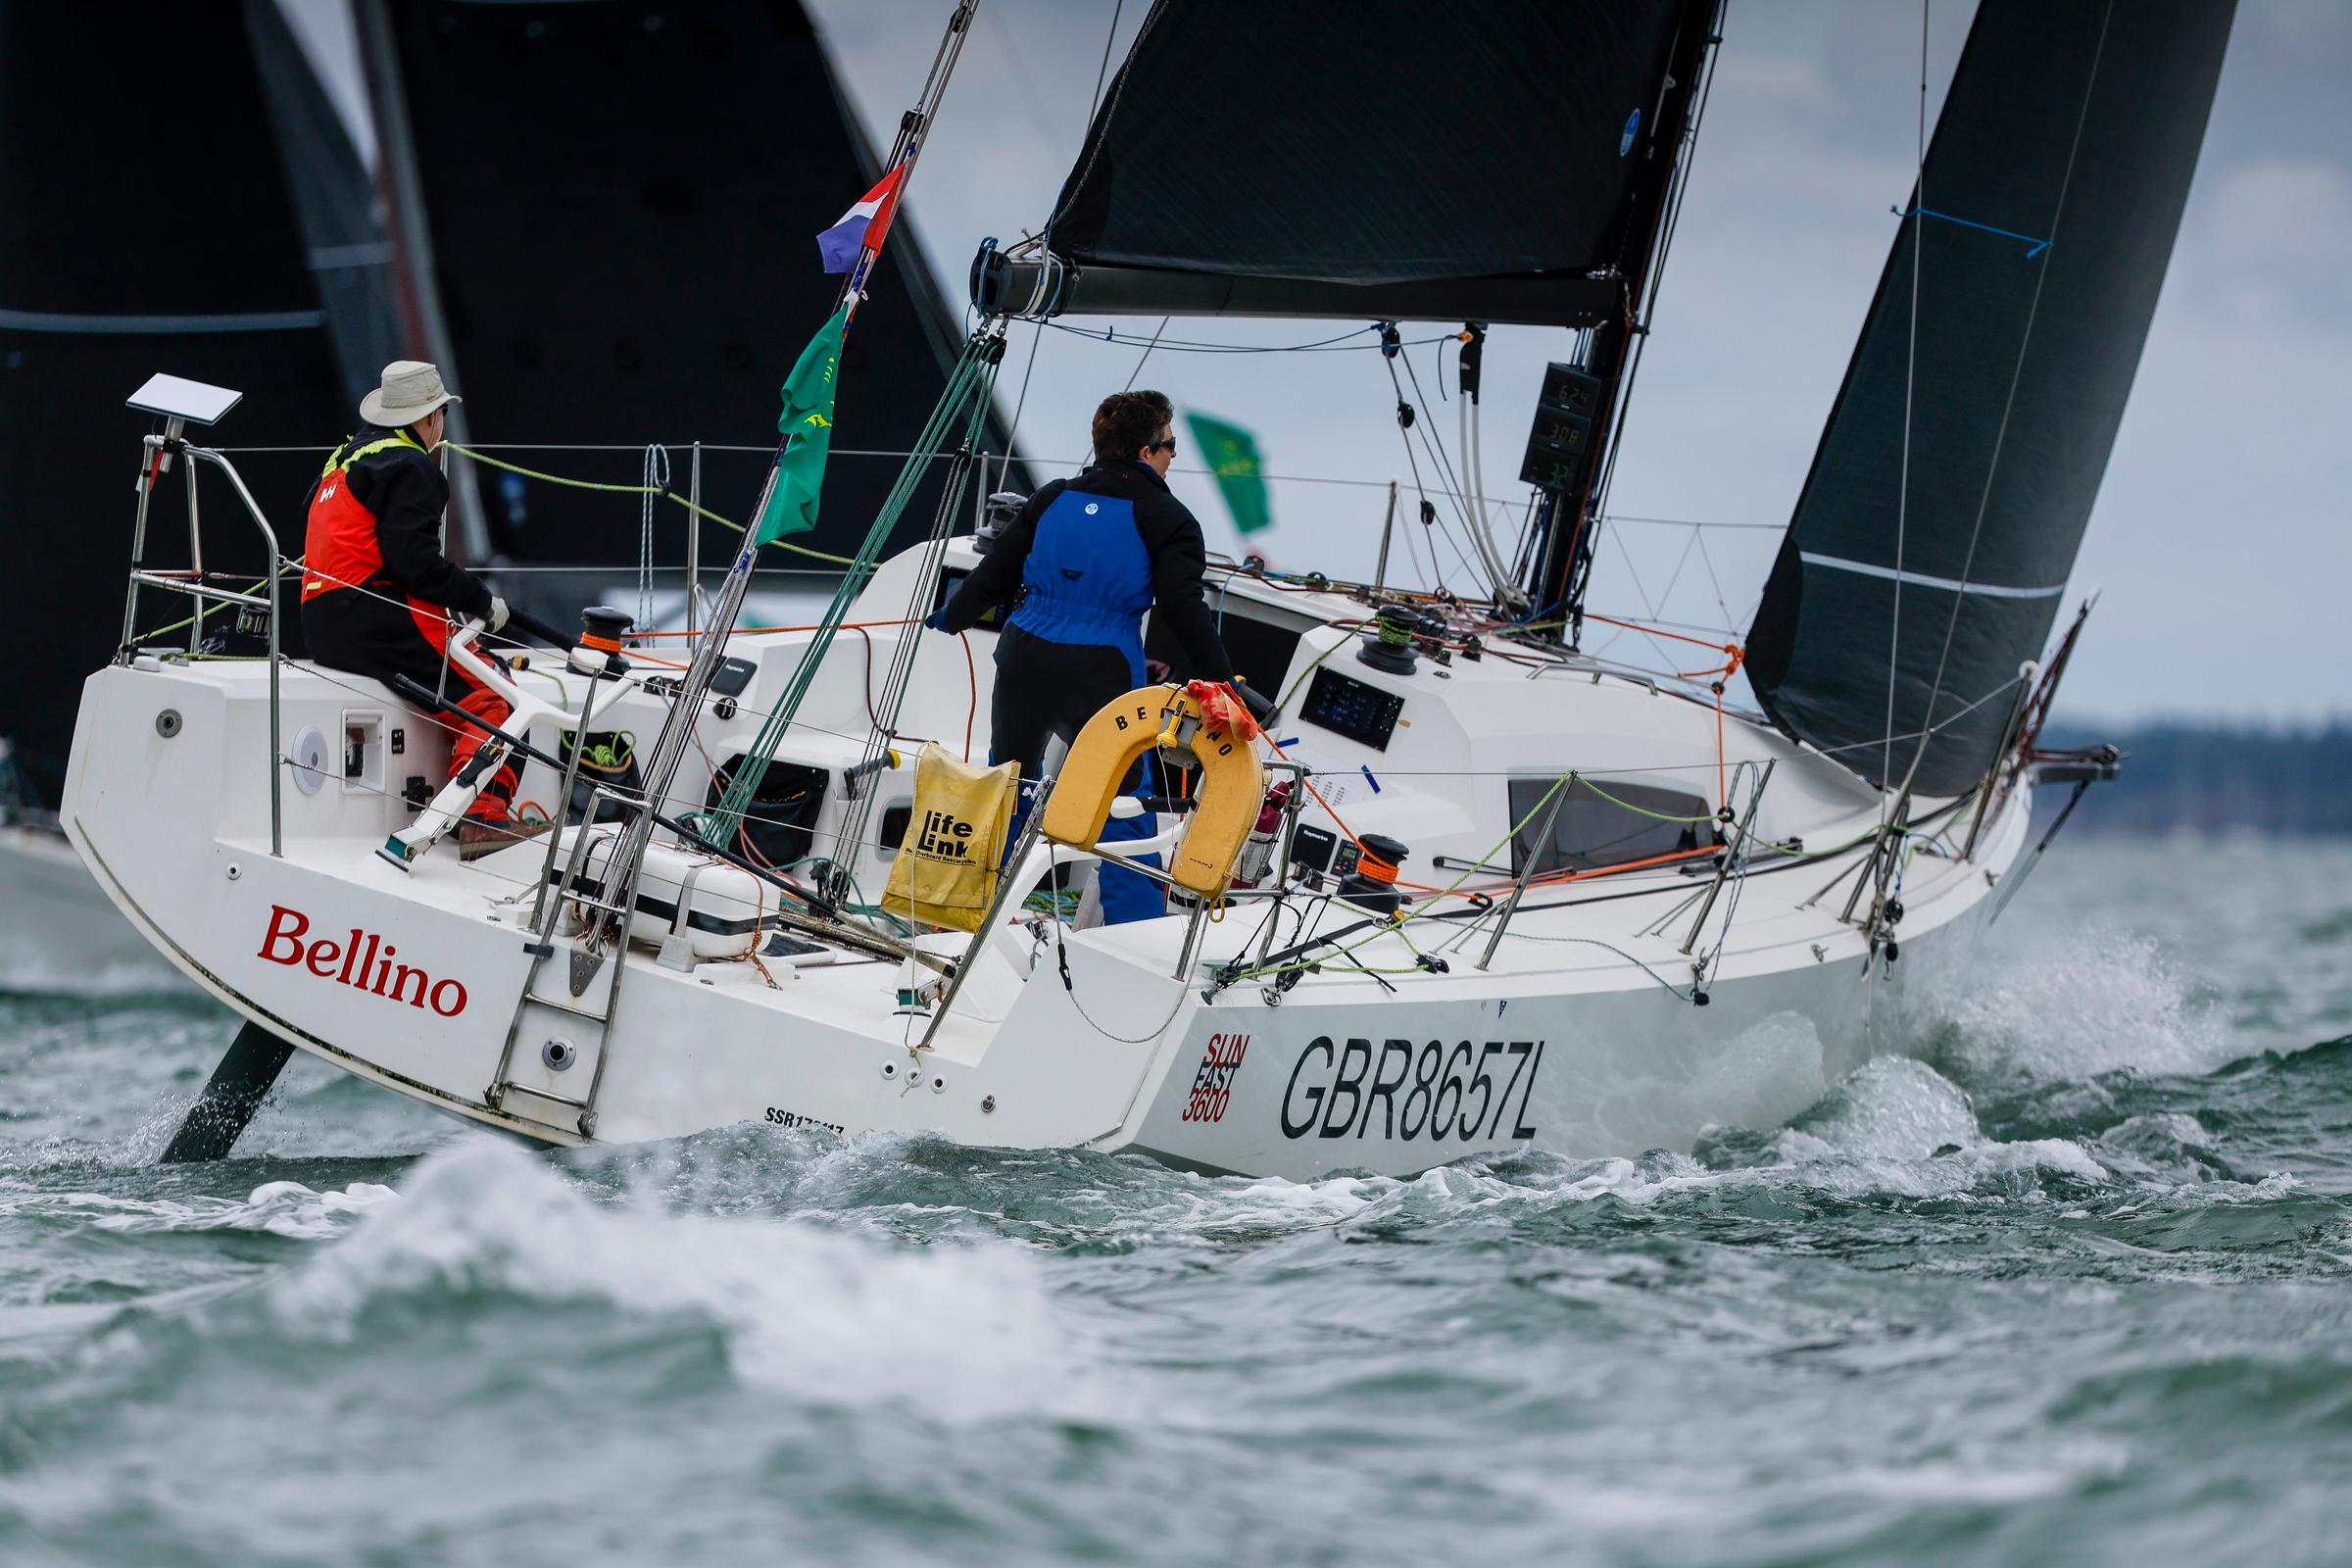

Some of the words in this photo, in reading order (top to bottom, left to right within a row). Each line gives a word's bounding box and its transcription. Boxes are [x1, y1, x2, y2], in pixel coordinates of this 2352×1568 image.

[257, 904, 468, 1017] Bellino
[1202, 1033, 1251, 1069] SUN
[1189, 1061, 1243, 1100] FAST
[1280, 1035, 1545, 1142] GBR8657L
[1182, 1087, 1231, 1123] 3600
